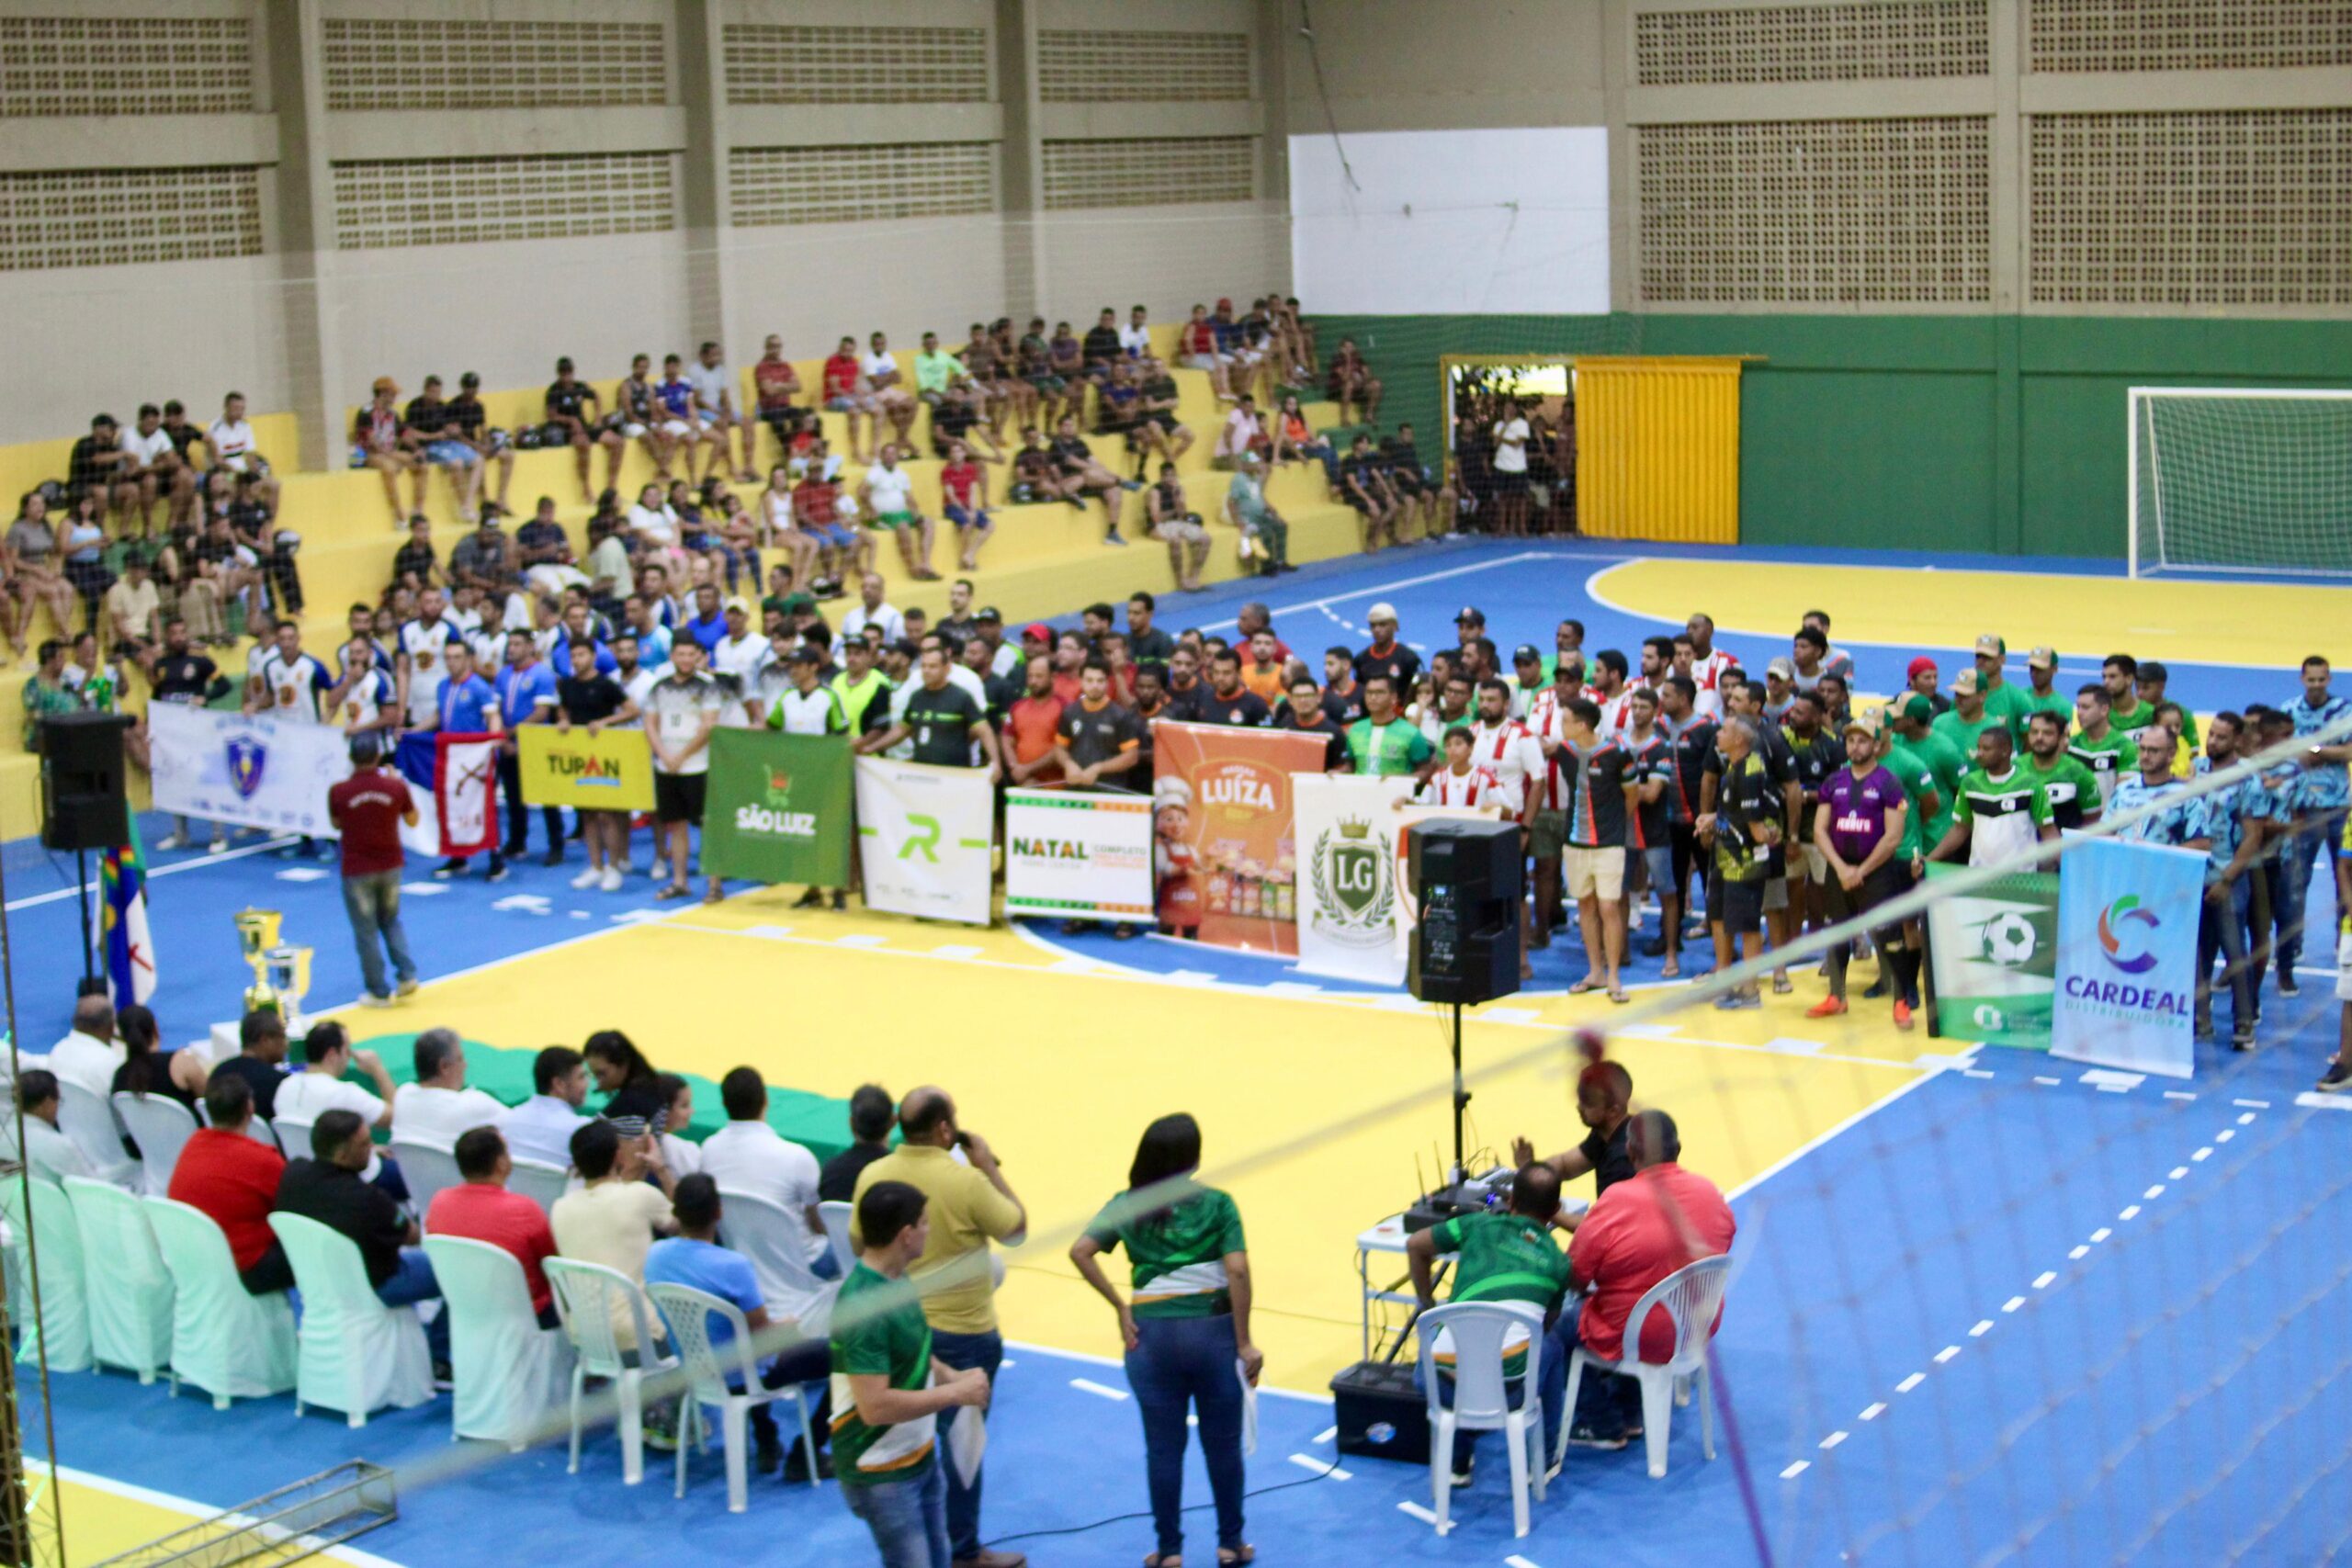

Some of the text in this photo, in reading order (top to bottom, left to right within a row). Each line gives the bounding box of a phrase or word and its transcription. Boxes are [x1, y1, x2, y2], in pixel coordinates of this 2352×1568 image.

[1071, 719, 1082, 735] 9
[547, 753, 620, 778] TUPAN
[1201, 773, 1275, 811] LUÍZA
[736, 802, 773, 832] SÃO
[775, 810, 817, 837] LUIZ
[897, 812, 942, 864] R
[1012, 836, 1090, 861] NATAL
[1093, 843, 1148, 856] COMPLETO
[1337, 853, 1374, 893] LG
[2064, 975, 2189, 1017] CARDEAL
[2064, 1000, 2187, 1030] DISTRIBUIDORA
